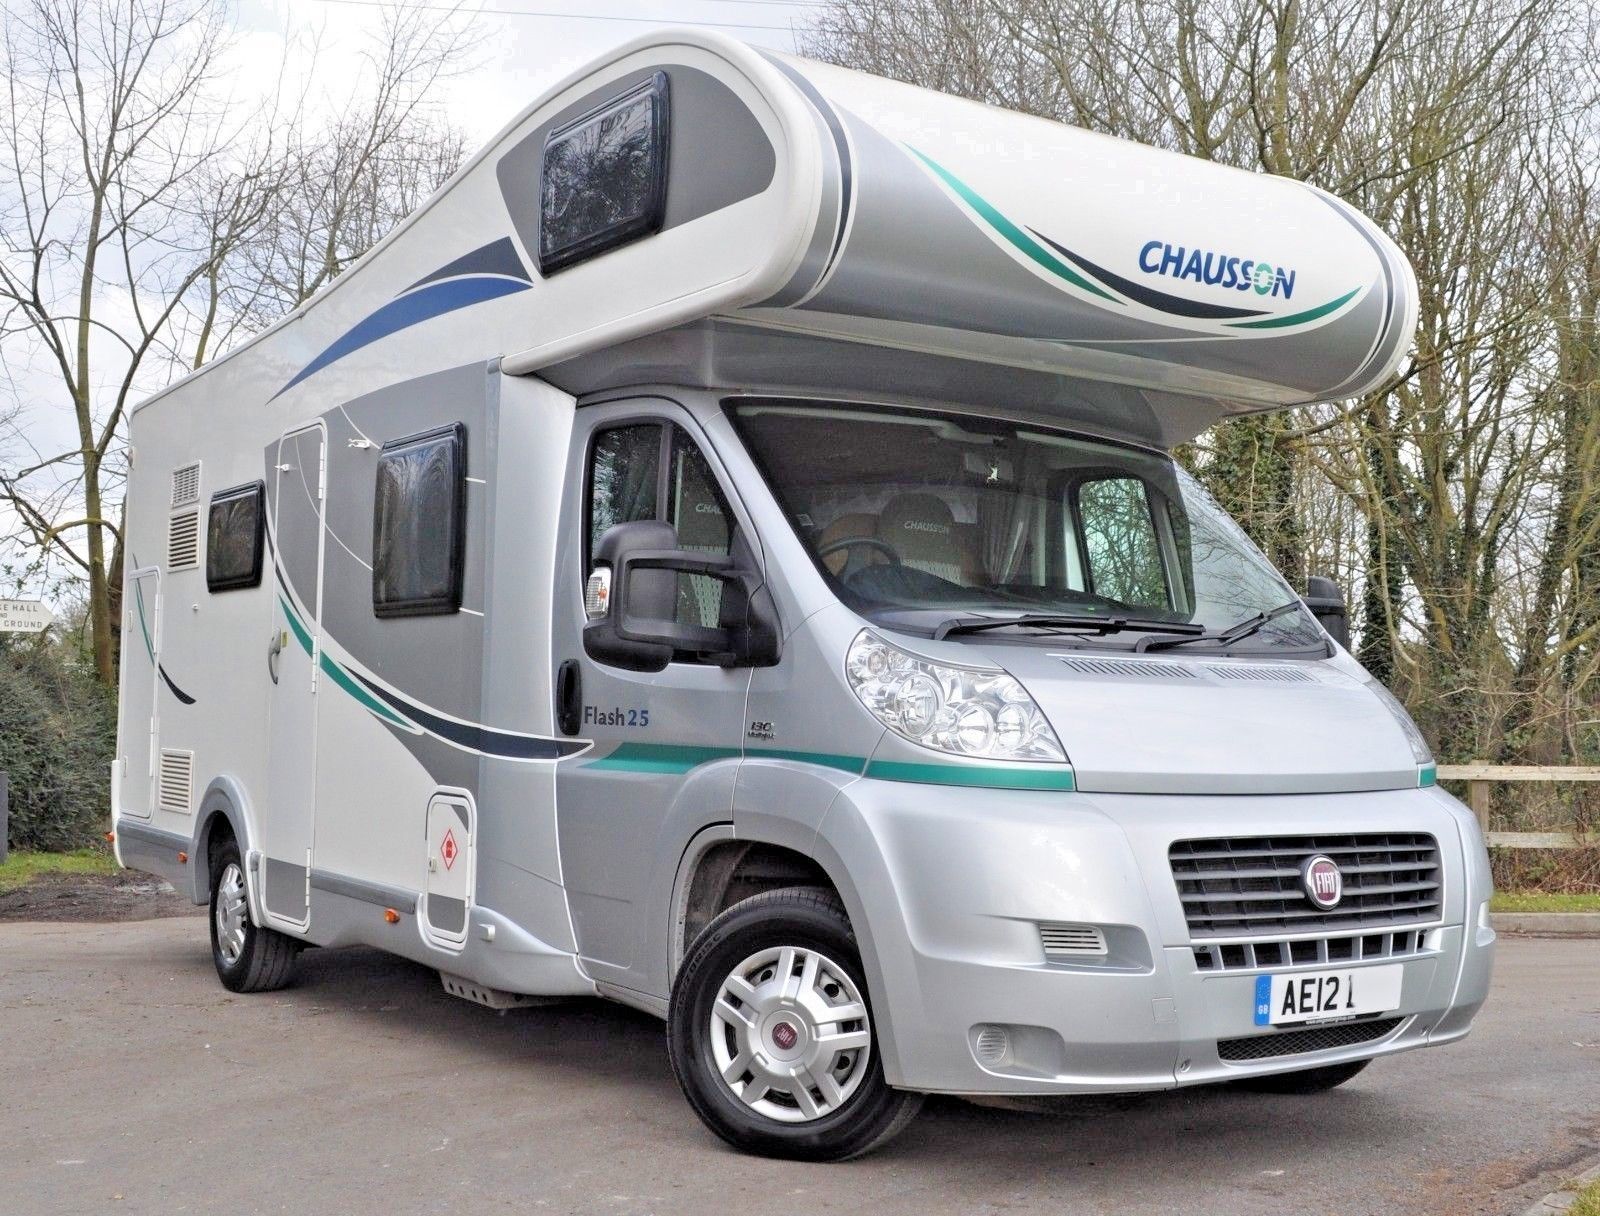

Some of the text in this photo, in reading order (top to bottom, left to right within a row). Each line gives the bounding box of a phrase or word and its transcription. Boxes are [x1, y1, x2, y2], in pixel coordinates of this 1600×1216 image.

[1139, 240, 1296, 300] CHAUSSON
[12, 604, 38, 612] HALL
[4, 620, 42, 628] GROUND
[1315, 872, 1336, 894] FIAT
[1257, 1004, 1269, 1014] GB
